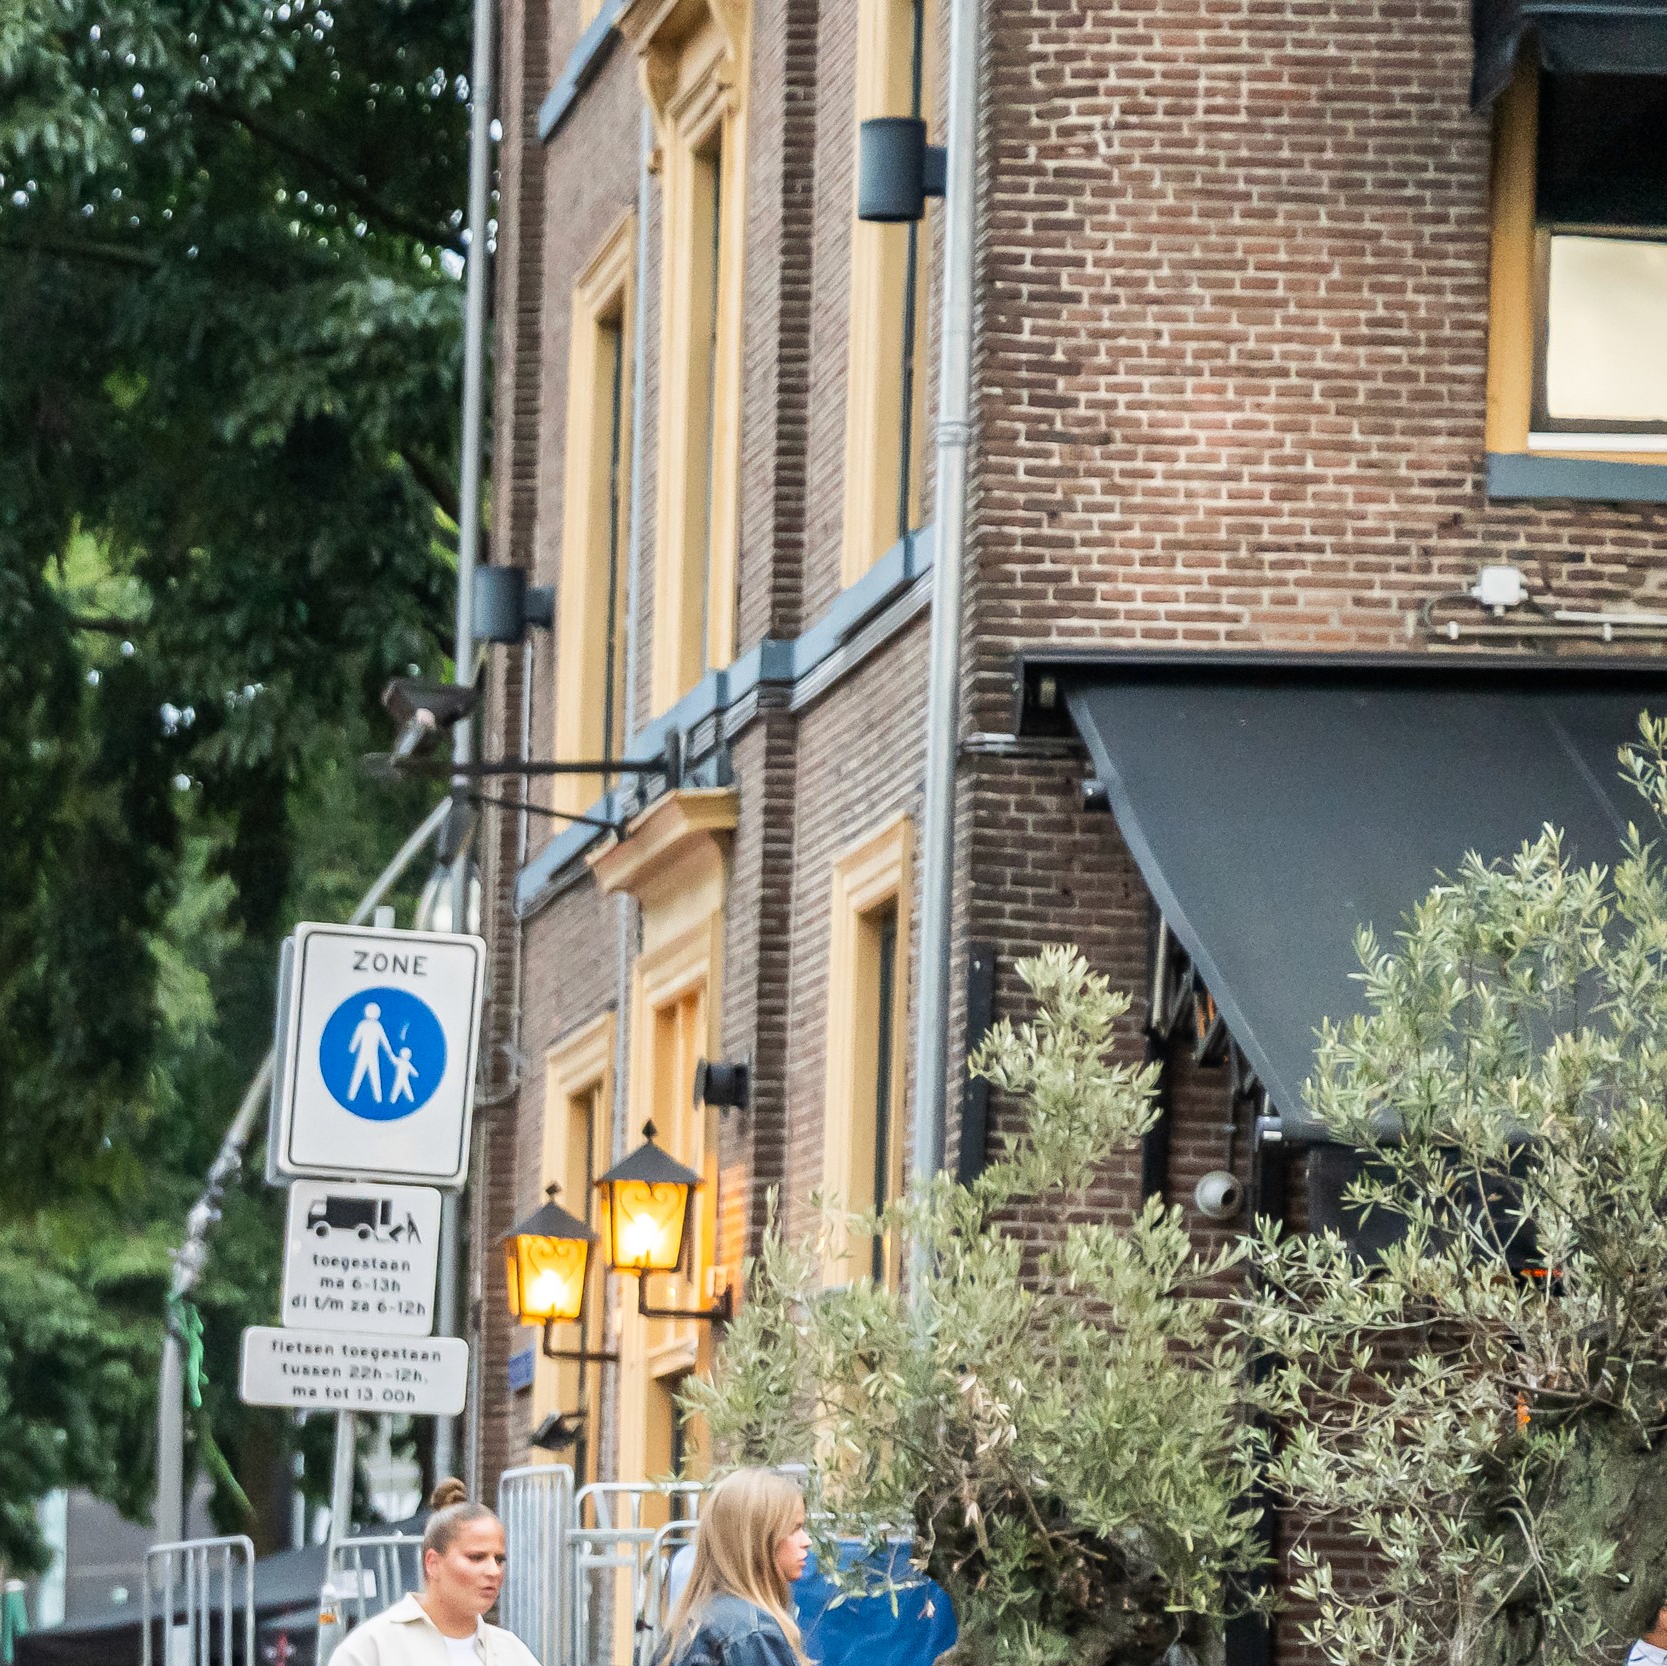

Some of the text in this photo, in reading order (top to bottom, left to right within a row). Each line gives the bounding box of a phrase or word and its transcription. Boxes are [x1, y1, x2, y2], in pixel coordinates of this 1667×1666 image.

[352, 950, 429, 977] ZONE
[313, 1254, 410, 1272] toegestaan
[320, 1277, 401, 1293] ma 6-13h
[291, 1294, 426, 1316] di t/m za 6-12h
[271, 1339, 442, 1363] fietsen toegestaan
[282, 1361, 342, 1378] tussen
[291, 1384, 318, 1398] ma
[324, 1386, 349, 1400] tot
